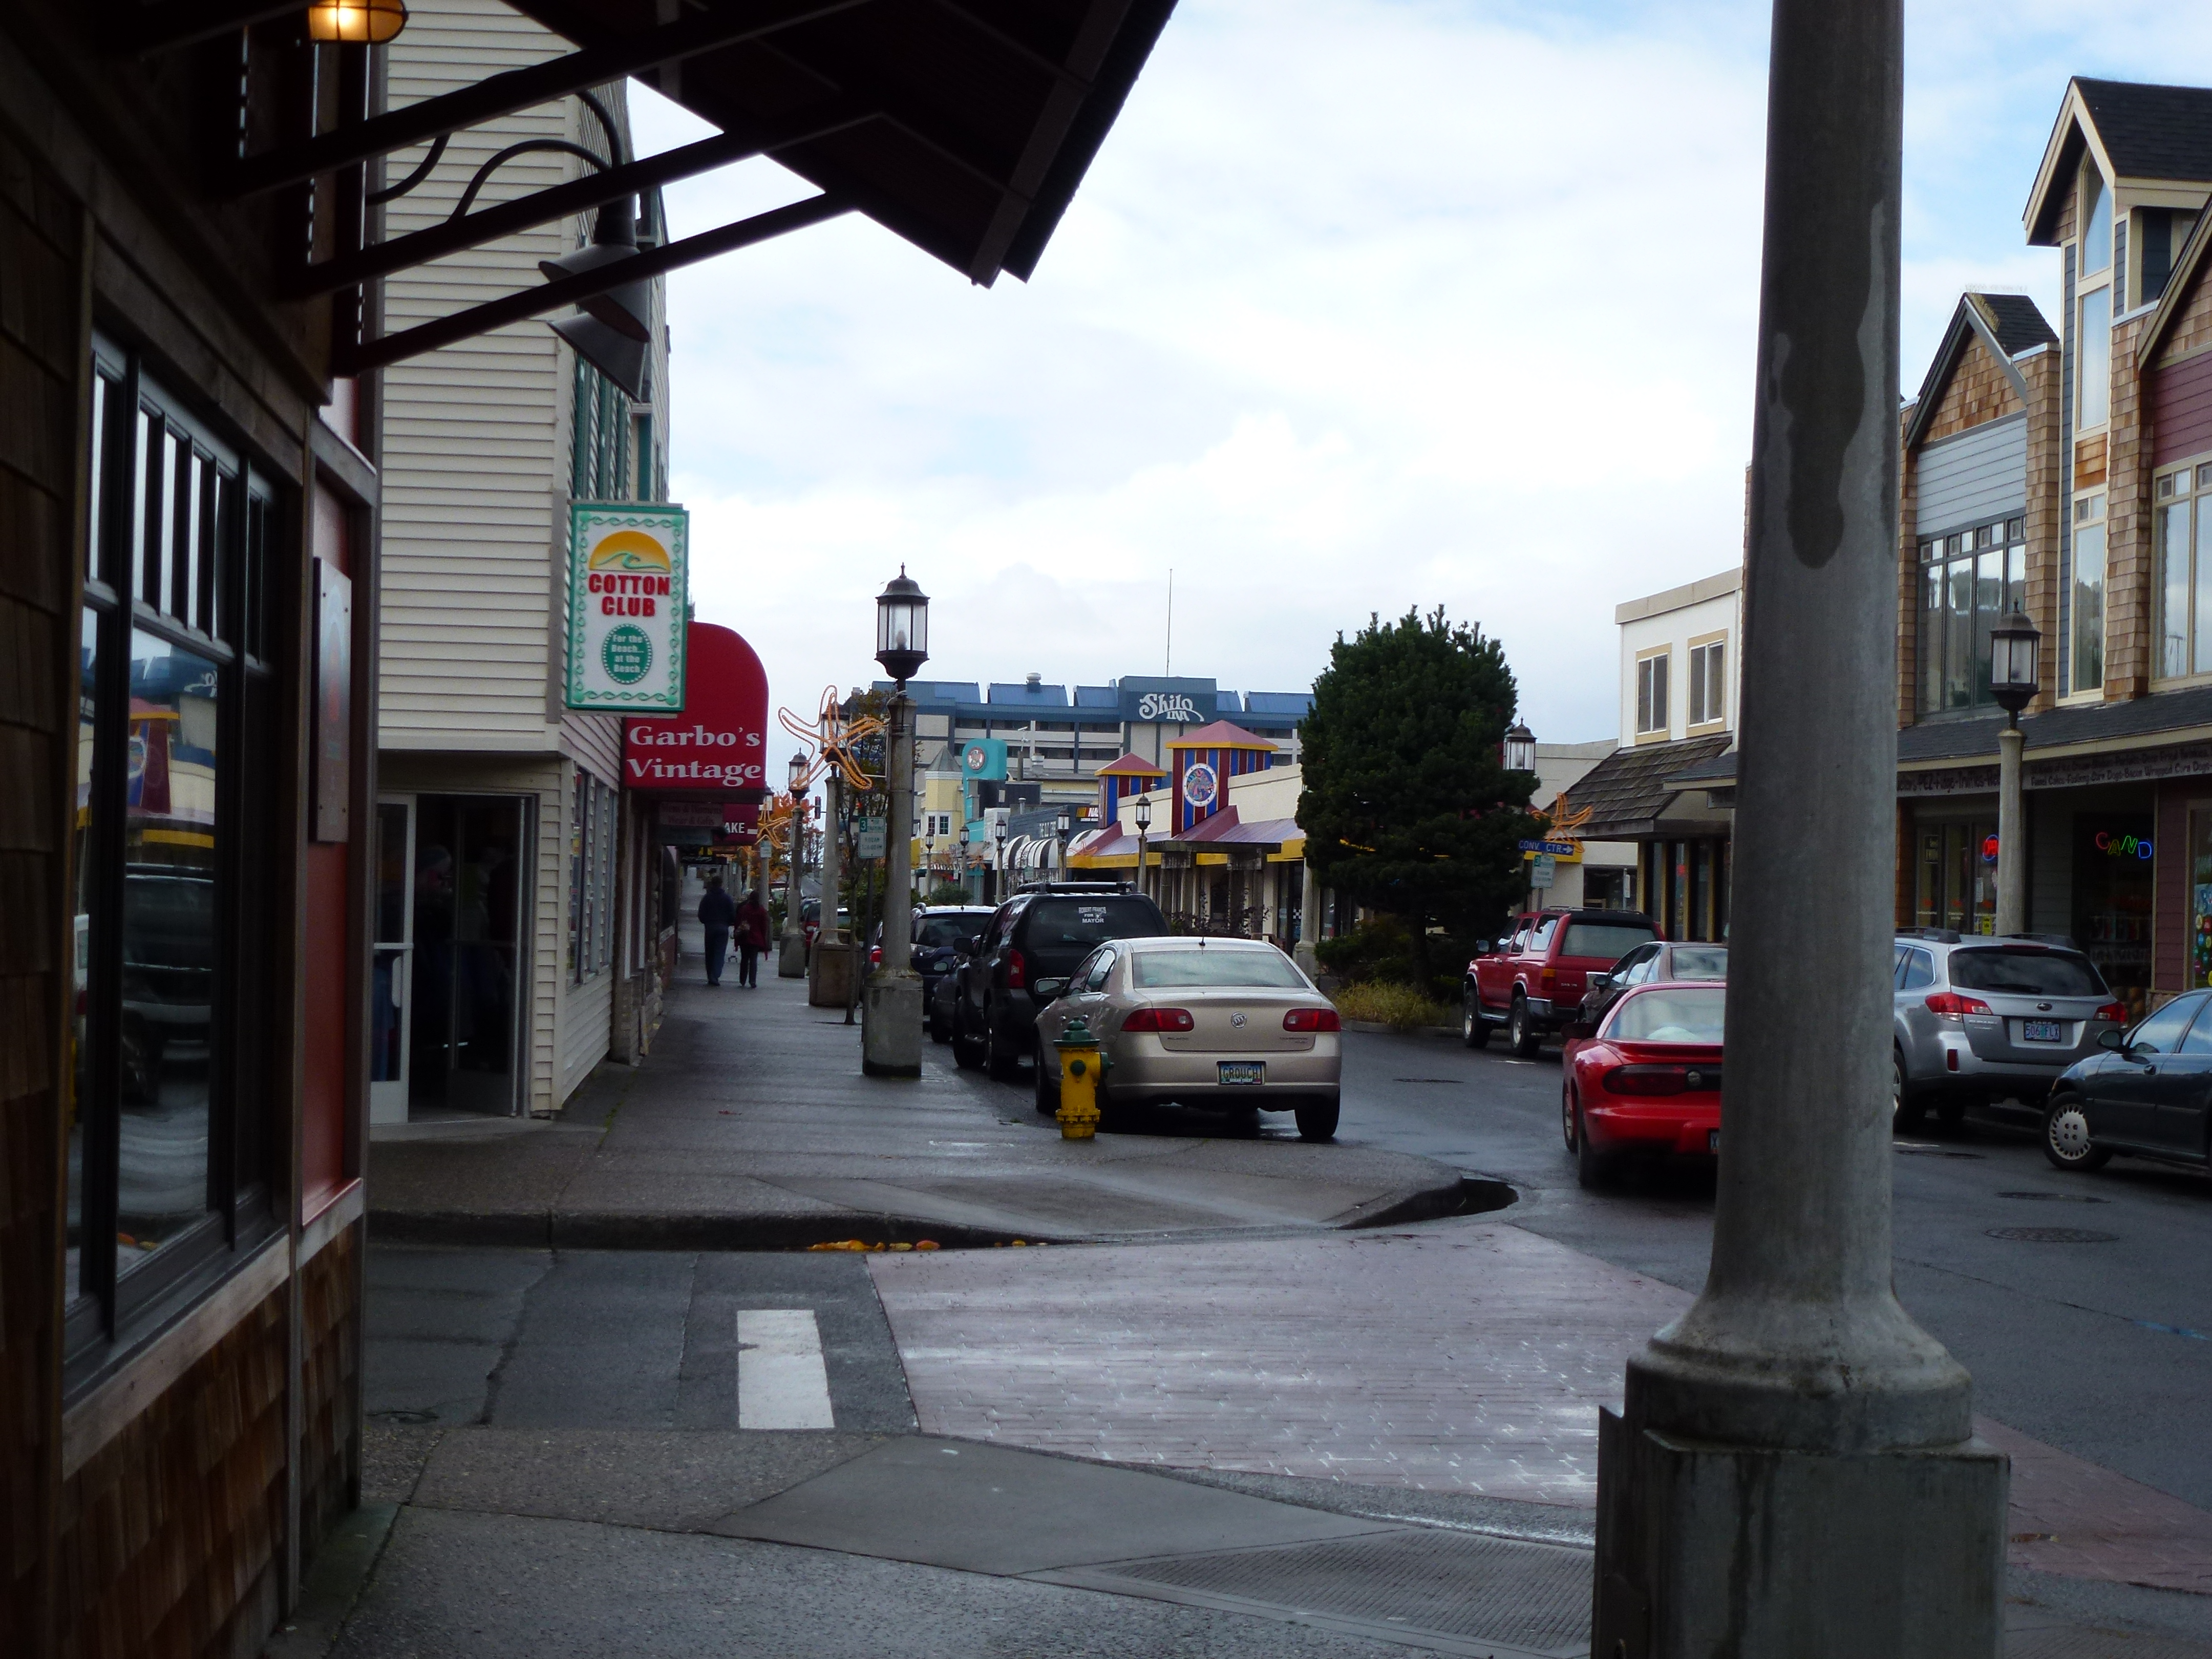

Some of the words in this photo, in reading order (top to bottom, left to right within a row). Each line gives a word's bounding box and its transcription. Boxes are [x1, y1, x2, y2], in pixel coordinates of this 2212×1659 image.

[588, 573, 670, 595] COTTON
[601, 597, 656, 616] CLUB
[612, 634, 626, 643] For
[628, 635, 643, 643] the
[613, 664, 641, 673] Beach
[1139, 693, 1204, 721] Shilo
[629, 725, 760, 747] Garbo's
[626, 758, 762, 787] Vintage
[724, 822, 745, 834] AKE
[861, 820, 866, 830] 3
[2095, 831, 2154, 859] CAND
[2026, 1025, 2040, 1036] 506
[2045, 1026, 2059, 1037] FLX
[1223, 1067, 1259, 1079] GROUCH
